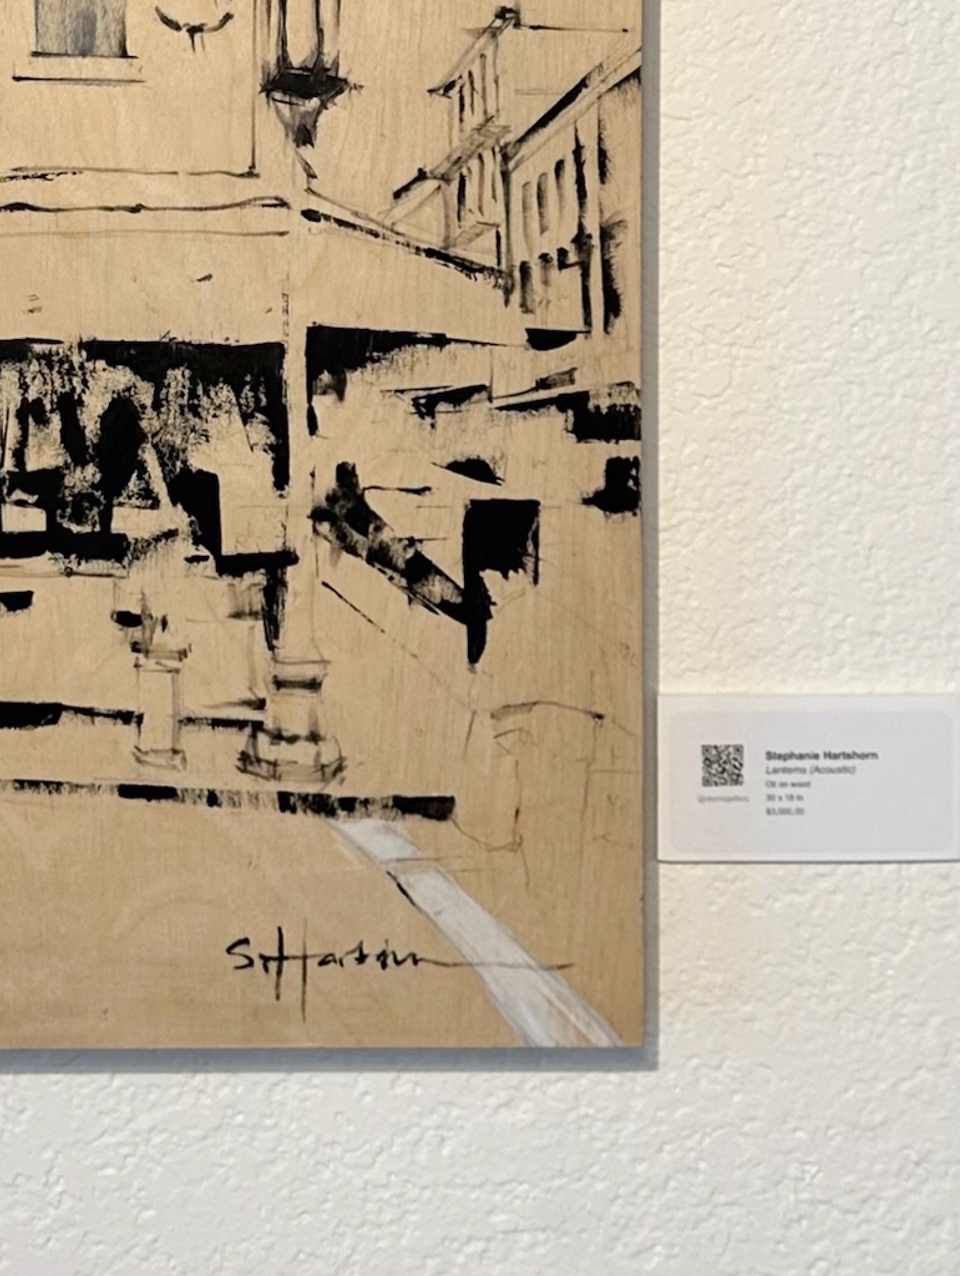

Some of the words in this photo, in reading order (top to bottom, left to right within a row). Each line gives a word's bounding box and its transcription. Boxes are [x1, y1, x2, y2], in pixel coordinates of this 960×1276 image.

[765, 750, 820, 761] Stephanie
[823, 750, 879, 760] Hartshorn
[809, 765, 856, 776] (Acoustic)
